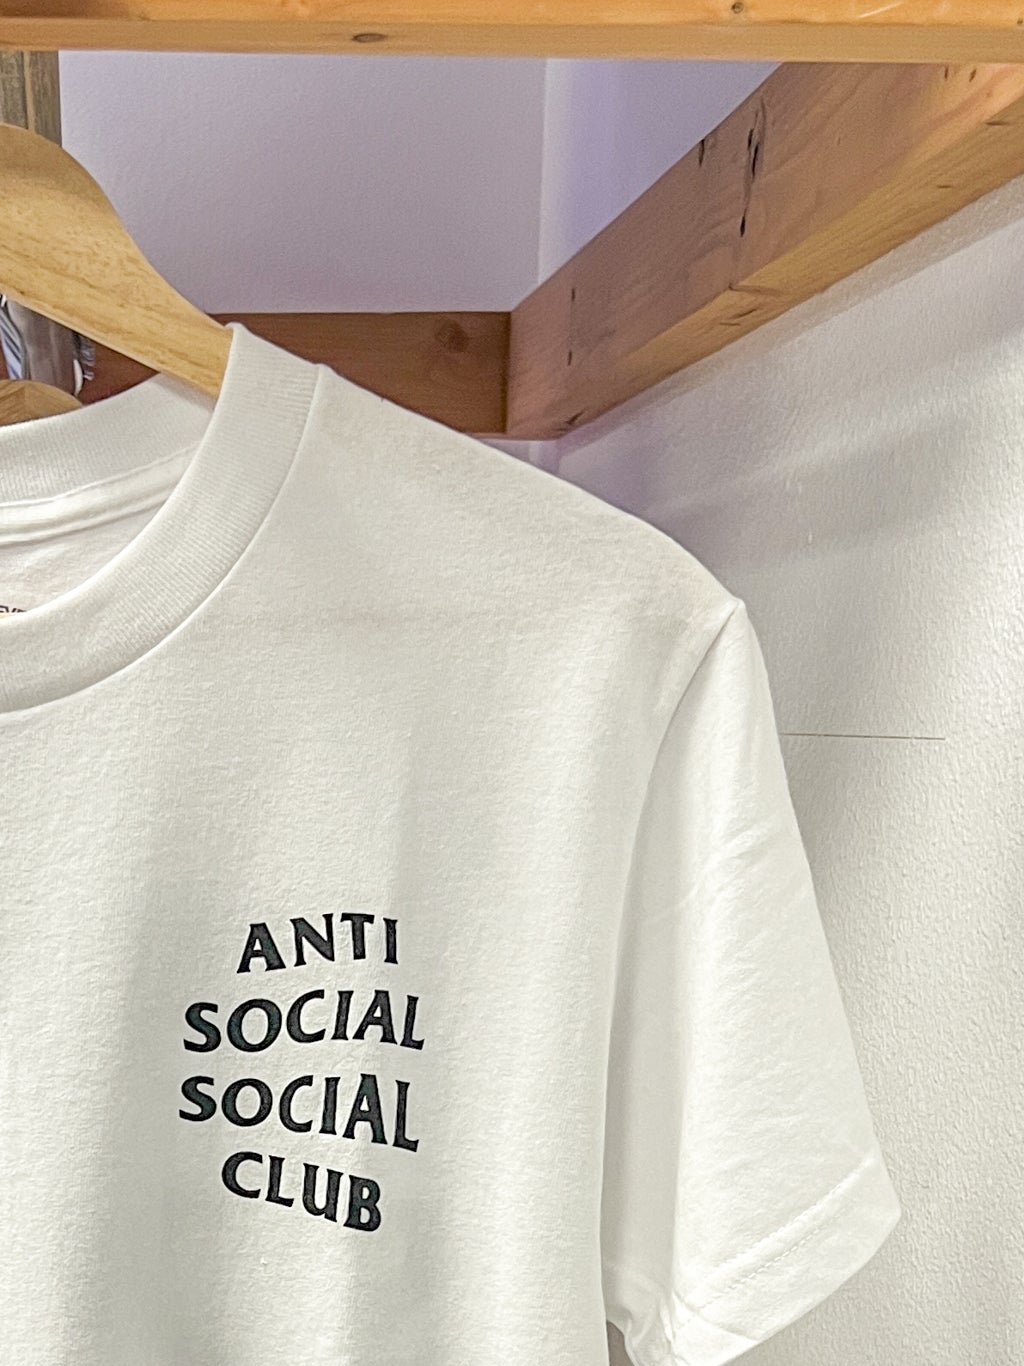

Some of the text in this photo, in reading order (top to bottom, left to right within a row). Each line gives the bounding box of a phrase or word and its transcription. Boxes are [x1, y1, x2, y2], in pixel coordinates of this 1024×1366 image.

[236, 912, 399, 974] ANTI
[183, 989, 425, 1053] SOCIAL
[178, 1073, 420, 1153] SOCIAL
[221, 1151, 382, 1232] CLUB
